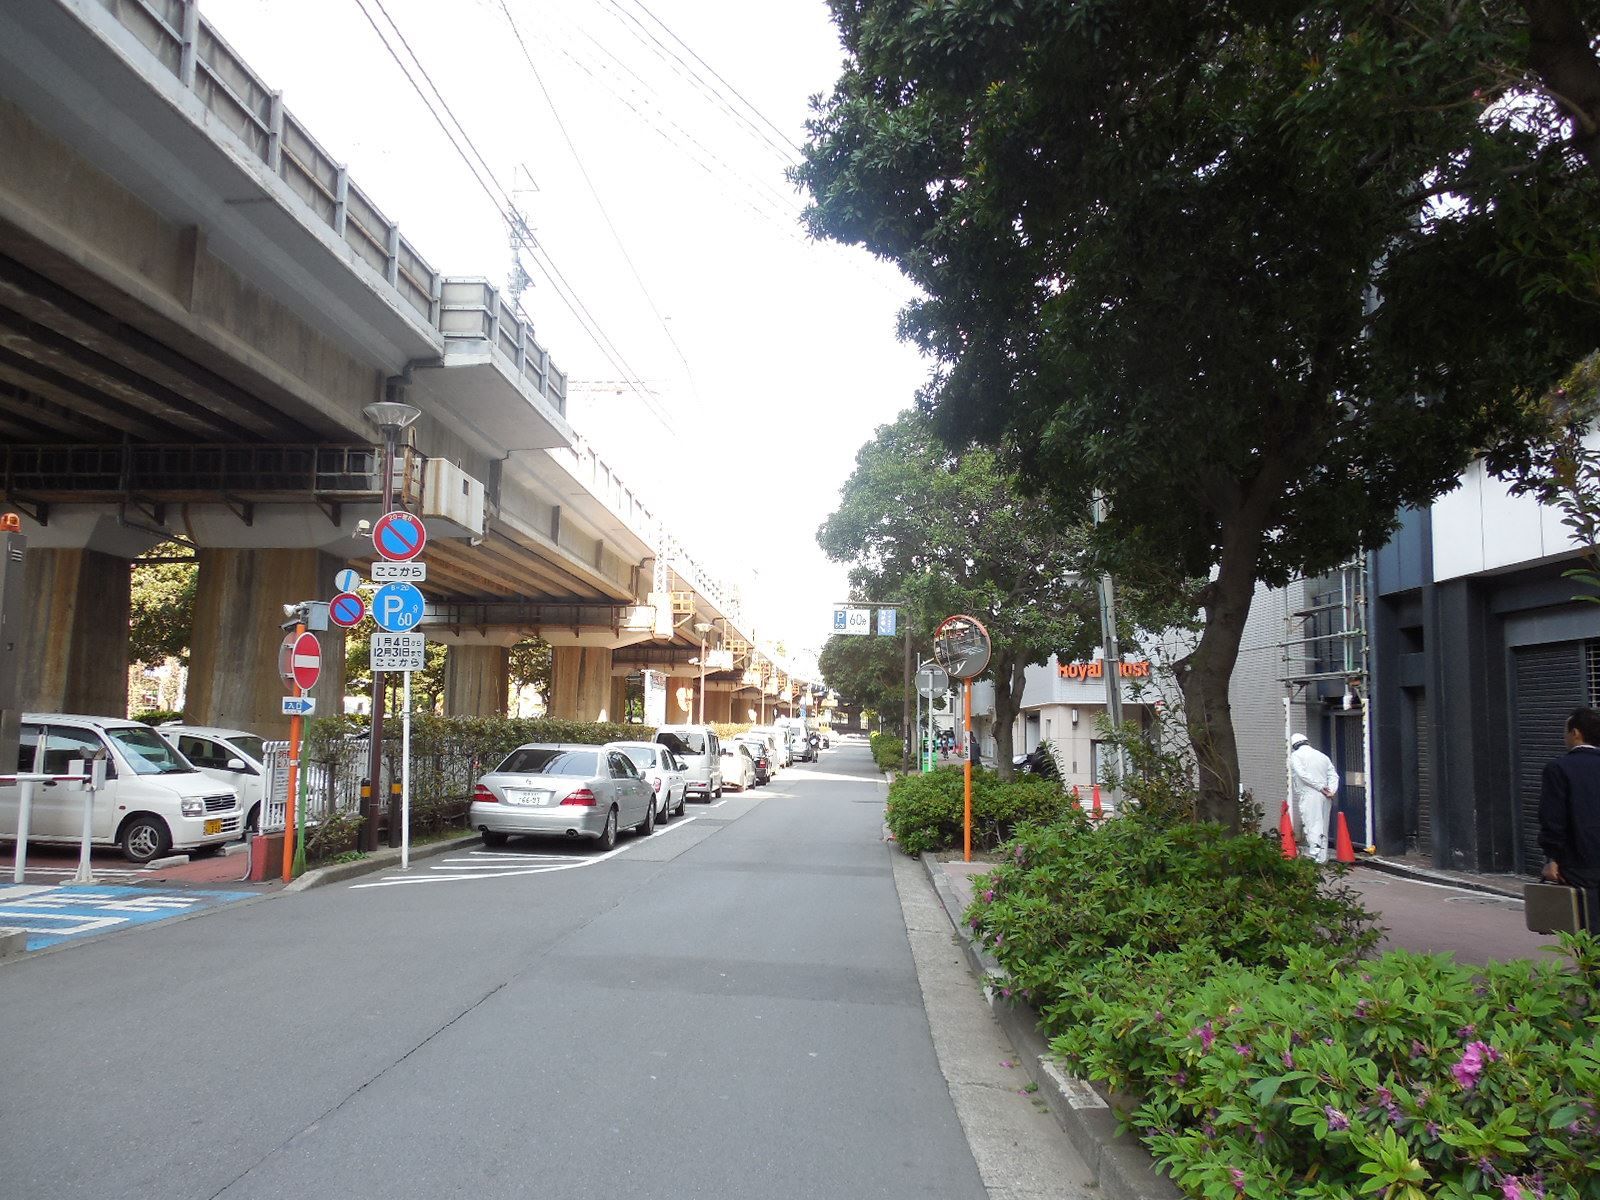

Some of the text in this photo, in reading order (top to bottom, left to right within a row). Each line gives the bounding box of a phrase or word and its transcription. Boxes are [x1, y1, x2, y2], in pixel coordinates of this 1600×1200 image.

[375, 566, 422, 577] ここから
[384, 595, 404, 626] P
[836, 611, 845, 623] P
[376, 637, 422, 647] 1月4日から
[373, 647, 422, 658] 12月31日まで
[375, 658, 420, 668] ここから
